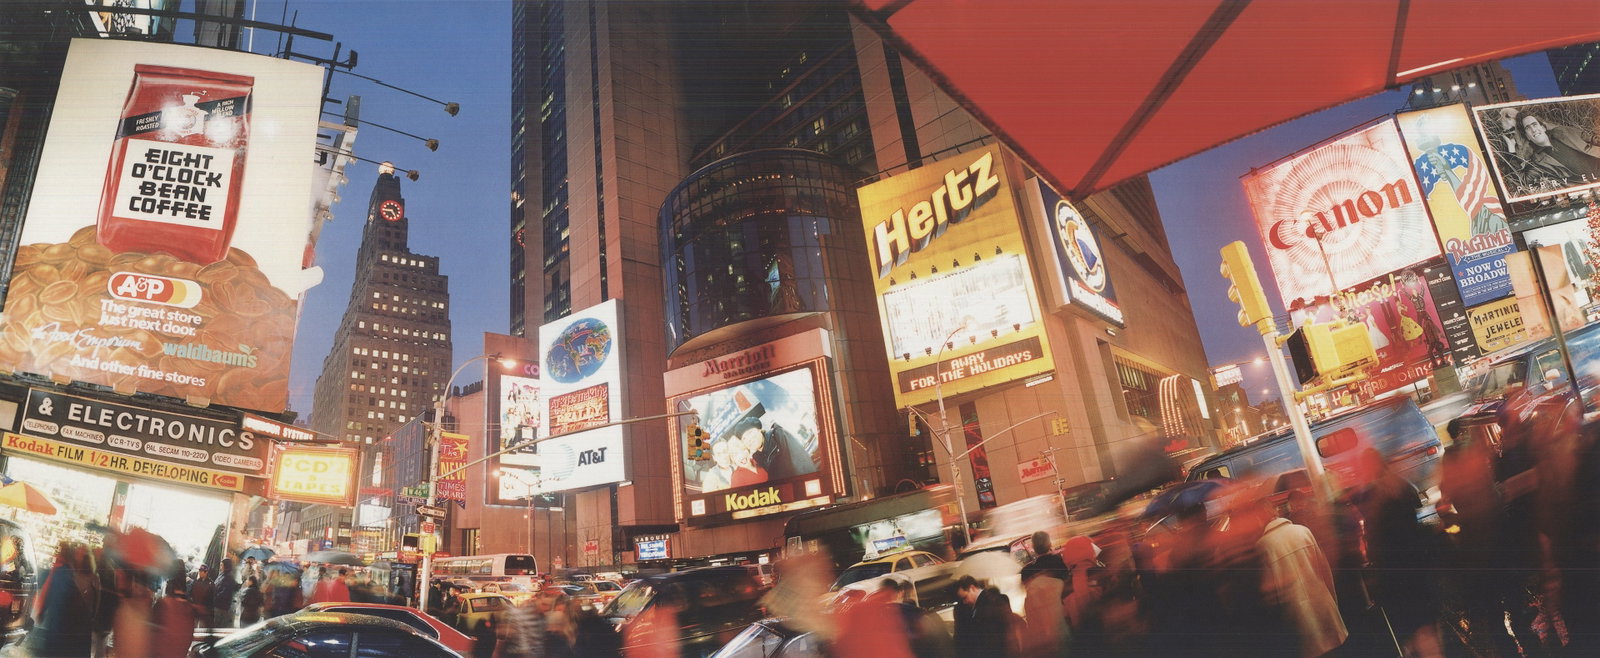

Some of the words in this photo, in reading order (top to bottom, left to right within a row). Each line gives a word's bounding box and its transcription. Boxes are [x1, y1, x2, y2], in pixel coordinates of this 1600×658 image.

[136, 115, 159, 125] FRESHLY
[136, 122, 160, 131] ROASTED
[145, 148, 214, 170] EIGHT
[131, 163, 222, 188] O'CLOCK
[1516, 177, 1568, 194] PERRY
[139, 181, 206, 203] BEAN
[129, 196, 212, 221] COFFEE
[873, 151, 1000, 278] Hertz
[1269, 178, 1413, 250] Canon
[1446, 229, 1514, 266] RAGTIME
[1459, 267, 1510, 288] BROADW
[1465, 261, 1492, 277] NOW
[117, 275, 165, 299] A&P
[100, 299, 127, 314] The
[127, 304, 166, 319] great
[167, 310, 203, 325] store
[128, 318, 161, 331] next
[162, 321, 197, 337] door.
[1486, 316, 1524, 339] JEWELE
[70, 354, 101, 369] And
[101, 360, 137, 375] other
[137, 365, 163, 381] fine
[165, 372, 206, 387] stores
[910, 377, 937, 390] FOR
[939, 368, 966, 383] THE
[970, 350, 1033, 376] HOLIDAYS
[951, 352, 986, 370] AWAY
[26, 420, 57, 433] TELEPHONES
[38, 397, 54, 416] &
[68, 403, 255, 450] ELECTRONICS
[62, 426, 74, 435] FAX
[75, 430, 104, 442] MACHINES
[7, 435, 54, 456] Kodak
[57, 445, 84, 461] FILM
[90, 451, 109, 466] 1/2
[110, 456, 129, 470] HR.
[133, 460, 209, 484] DEVELOPING
[146, 445, 158, 453] PAL
[158, 447, 180, 455] SECAM
[181, 450, 207, 460] 110-220V
[213, 454, 232, 464] VIDEO
[233, 458, 262, 468] CAMERAS
[440, 444, 457, 457] The
[577, 446, 608, 467] AT&T
[440, 461, 466, 480] NEW
[437, 481, 465, 492] TIMES
[437, 489, 465, 499] SQUARE
[725, 486, 782, 512] Kodak
